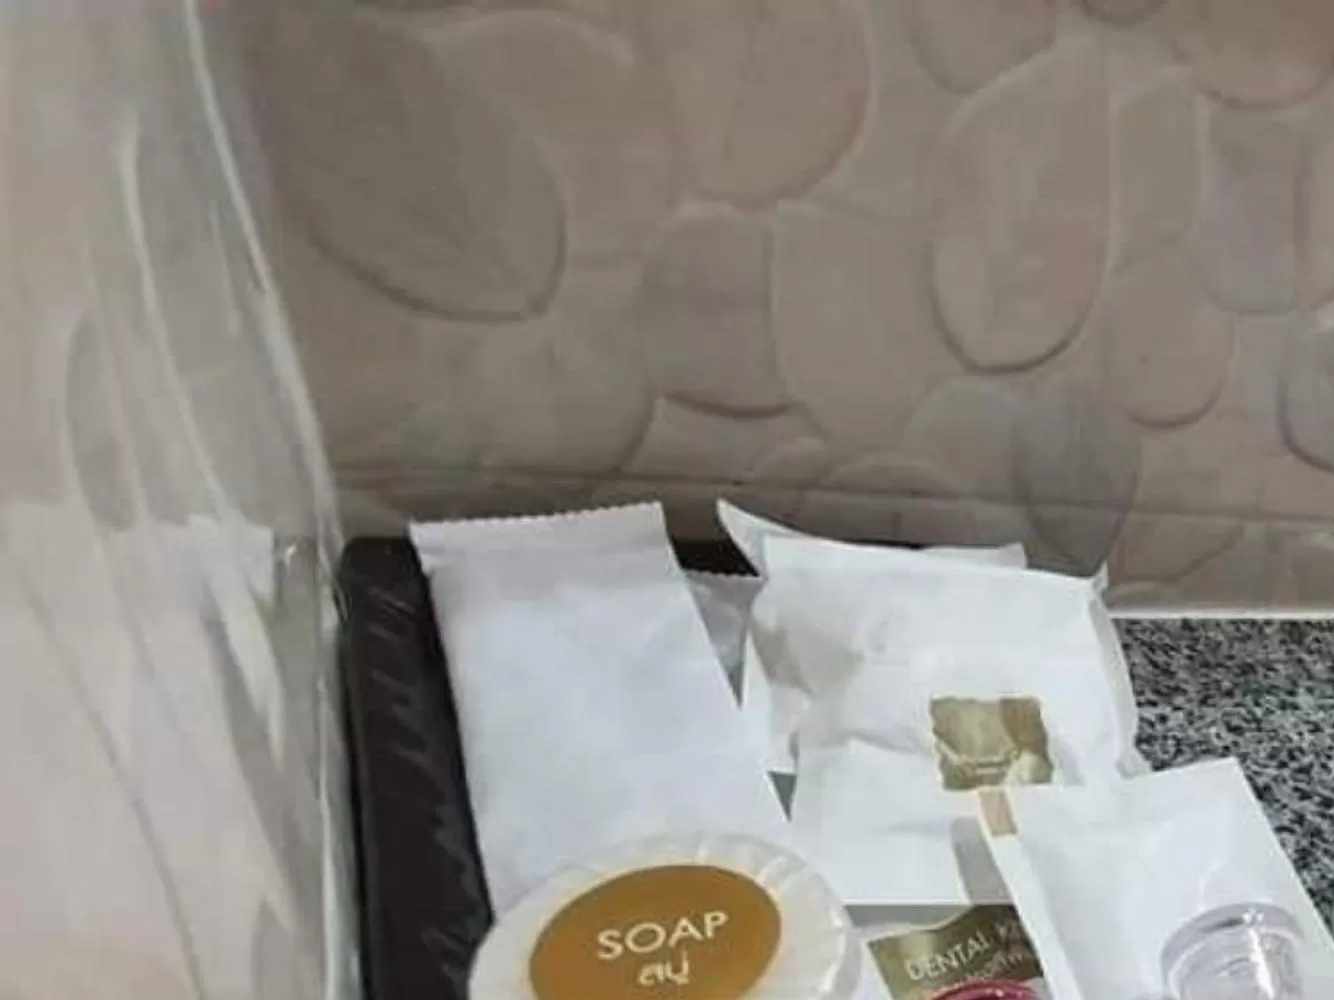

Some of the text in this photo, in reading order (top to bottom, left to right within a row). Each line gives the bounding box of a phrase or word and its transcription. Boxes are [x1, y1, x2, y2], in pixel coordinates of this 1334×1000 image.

[597, 910, 729, 961] SOAP
[904, 926, 991, 982] DENTAL
[637, 948, 690, 986] สบู่
